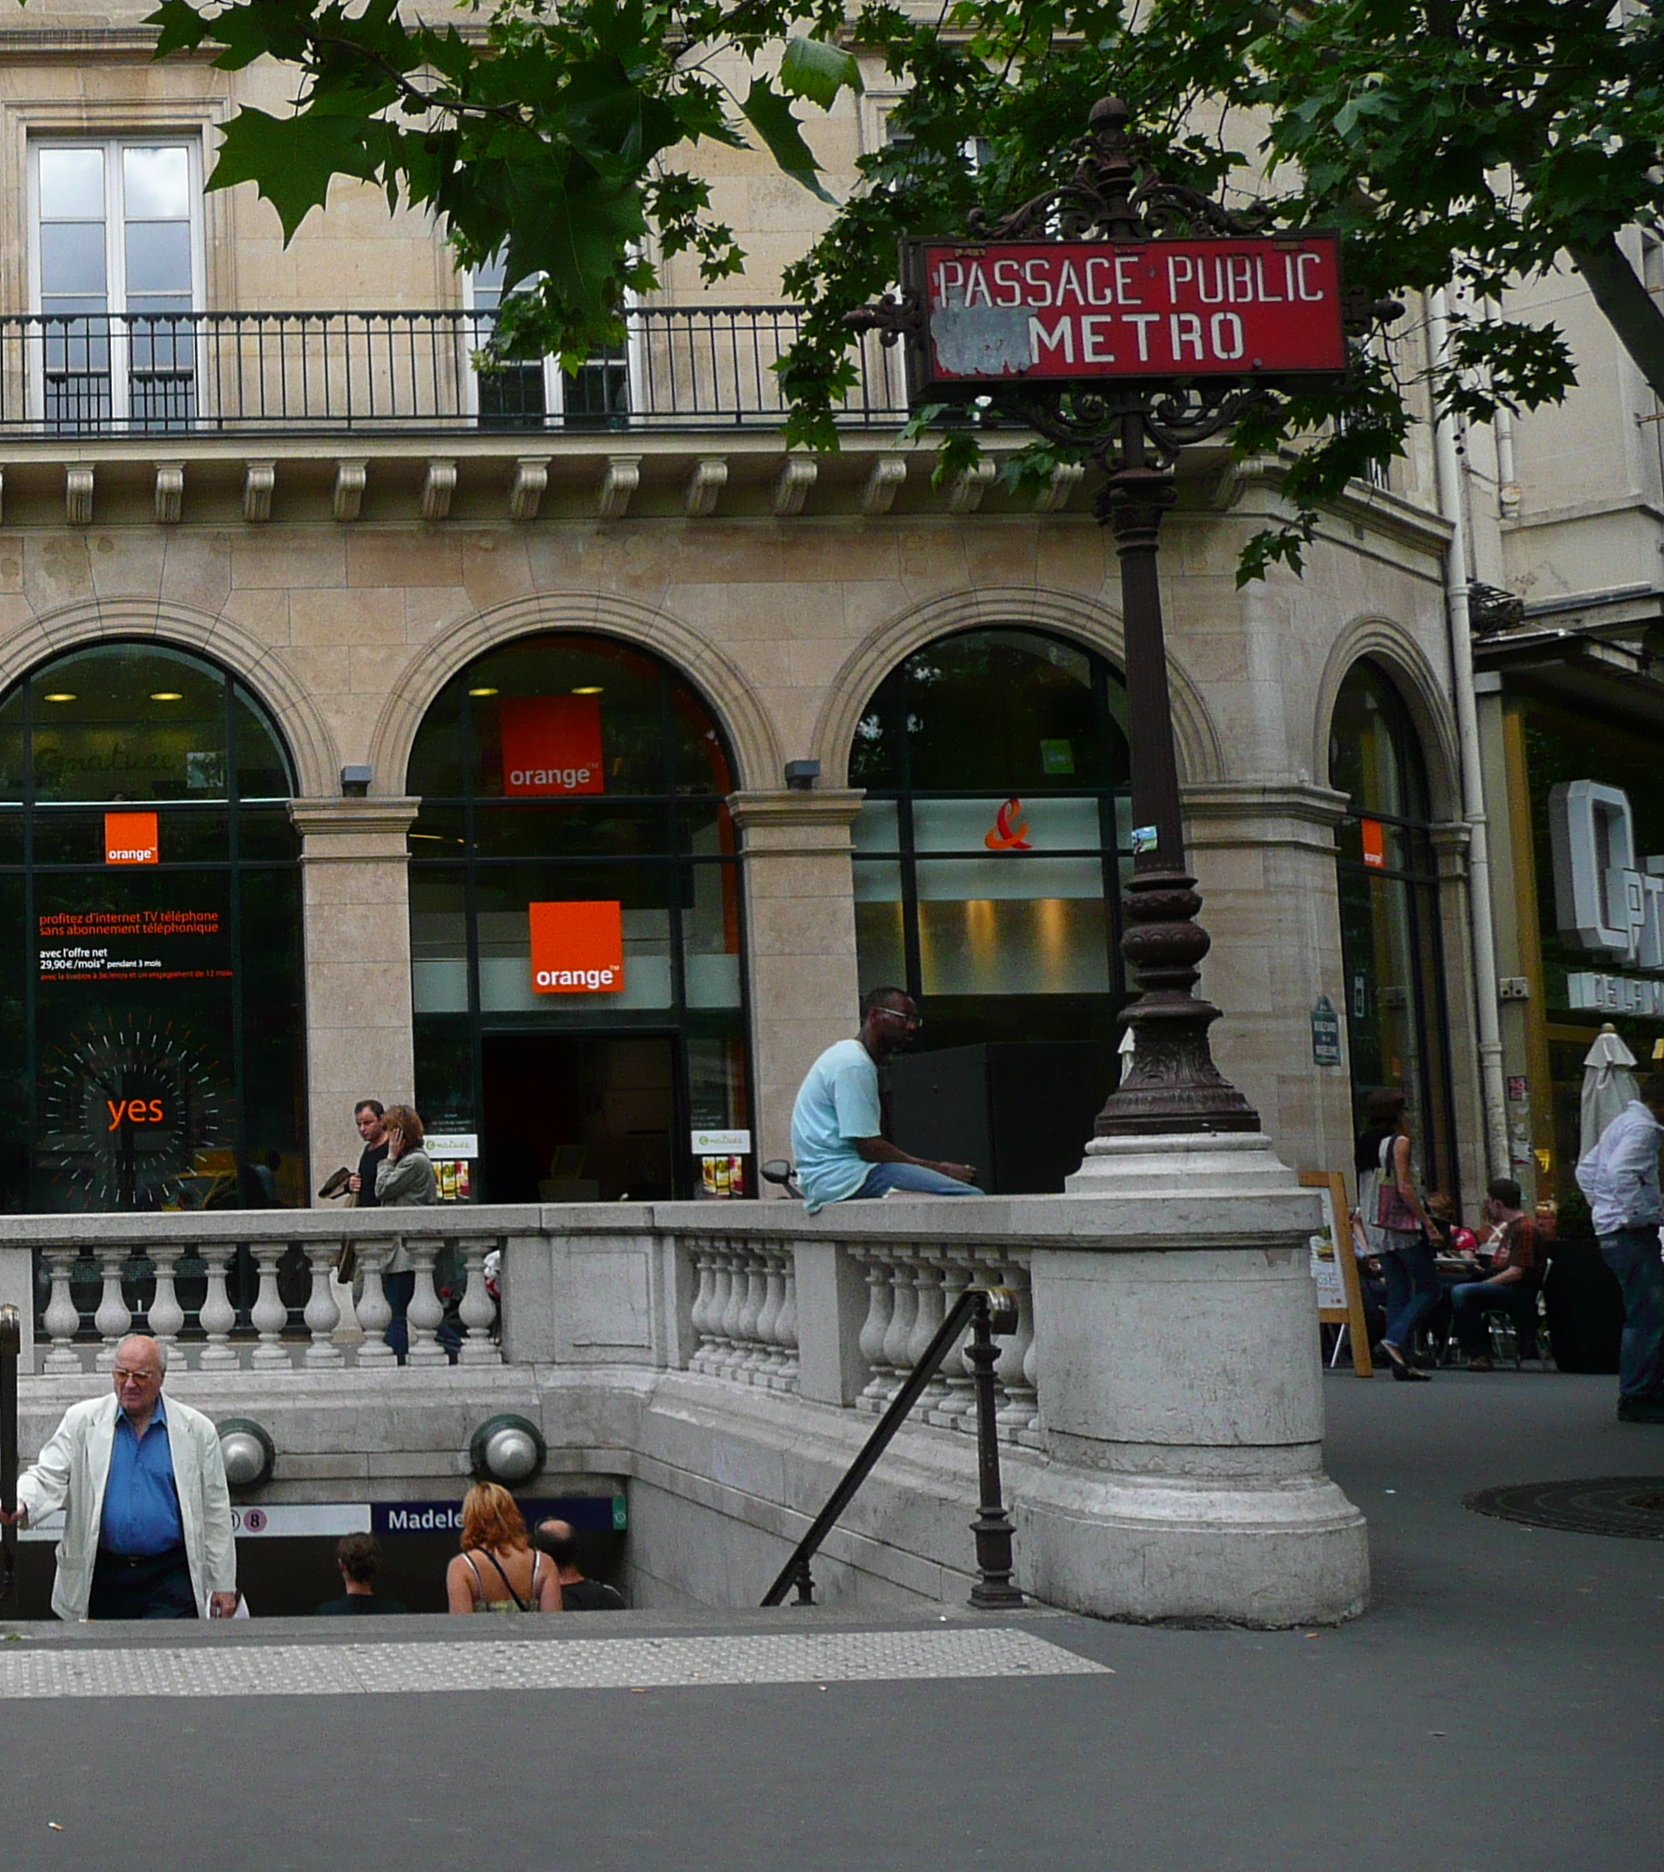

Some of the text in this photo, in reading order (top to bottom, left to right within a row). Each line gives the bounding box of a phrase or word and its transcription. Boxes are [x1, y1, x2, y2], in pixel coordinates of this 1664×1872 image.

[938, 252, 1325, 309] PASSAGE PUBLIC
[1027, 311, 1246, 364] METRO
[509, 764, 592, 789] orange
[39, 910, 219, 926] profitez d'internet TV téléphone
[39, 922, 219, 936] sans abonnement téléphonique
[39, 946, 109, 959] avec l'offre net
[107, 959, 137, 970] pendant
[137, 959, 143, 968] 3
[144, 959, 163, 968] mois
[536, 968, 614, 990] orange
[106, 1098, 165, 1132] yes
[387, 1509, 464, 1531] Madele
